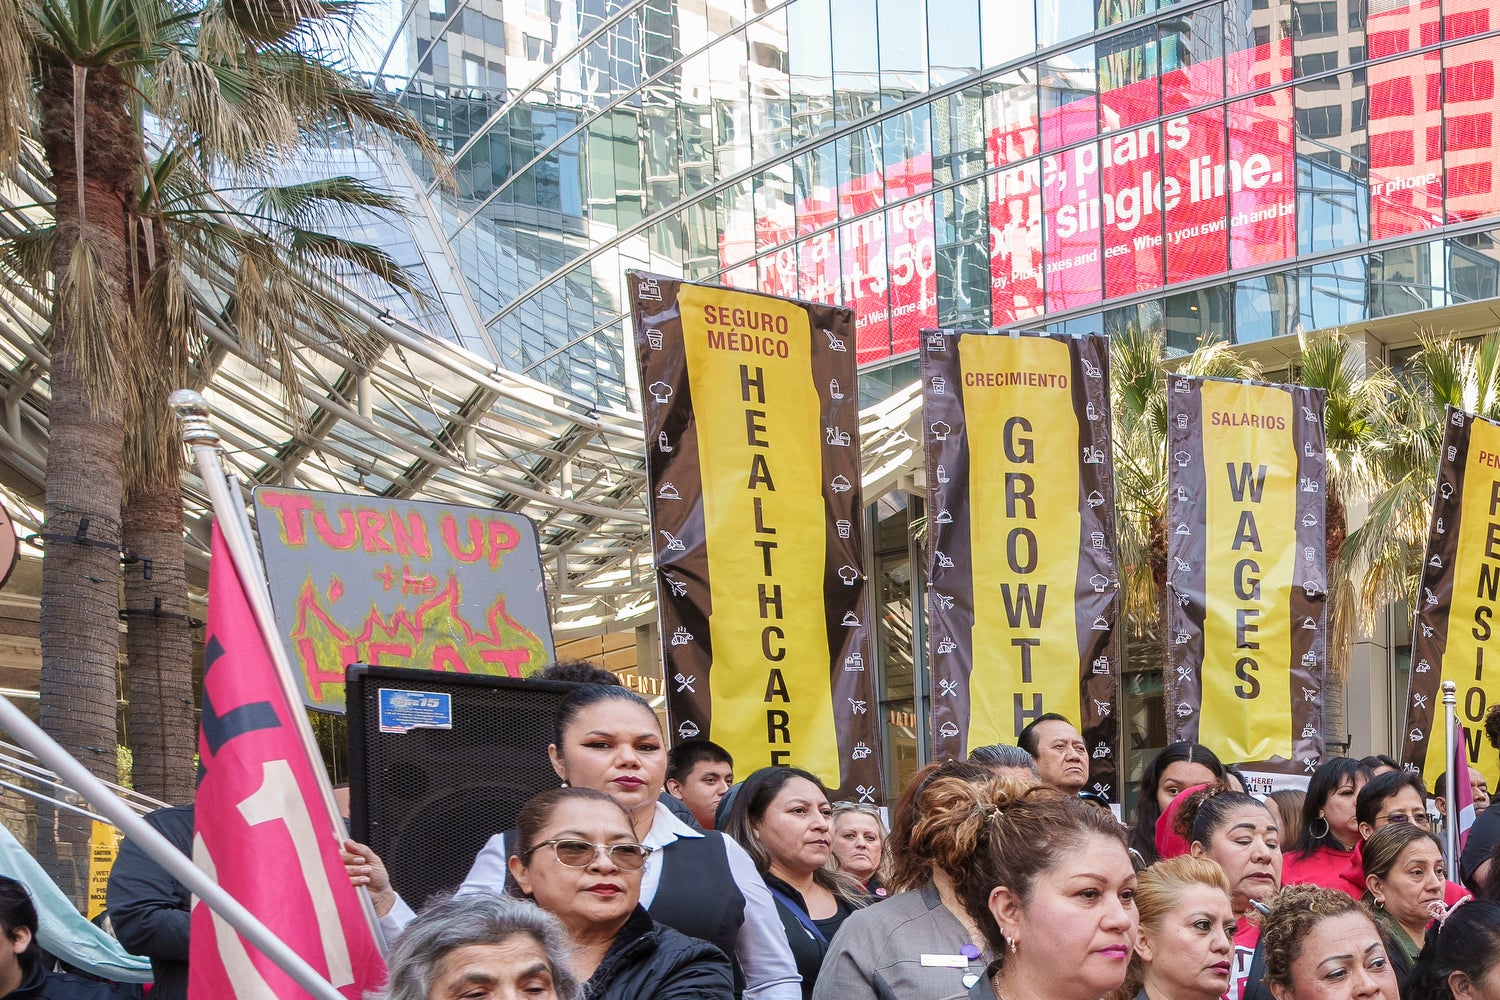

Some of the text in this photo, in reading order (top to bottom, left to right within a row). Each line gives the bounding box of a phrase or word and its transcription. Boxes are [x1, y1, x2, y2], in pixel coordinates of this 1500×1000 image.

[1075, 114, 1191, 187] plans
[1056, 169, 1182, 239] single
[1189, 152, 1282, 204] line.
[1385, 172, 1440, 197] phone.
[1074, 250, 1098, 269] and
[1132, 228, 1173, 249] When
[1174, 227, 1199, 246] you
[1250, 207, 1277, 223] and
[703, 304, 789, 335] SEGURO
[707, 328, 789, 359] MÉDICO
[965, 371, 1068, 389] CRECIMIENTO
[1211, 411, 1286, 431] SALARIOS
[261, 491, 523, 569] TURN UP
[375, 563, 438, 596] the
[1000, 416, 1047, 737] GROWTH
[1226, 462, 1267, 699] WAGES
[1251, 776, 1274, 785] HERE!
[1263, 784, 1273, 793] 11
